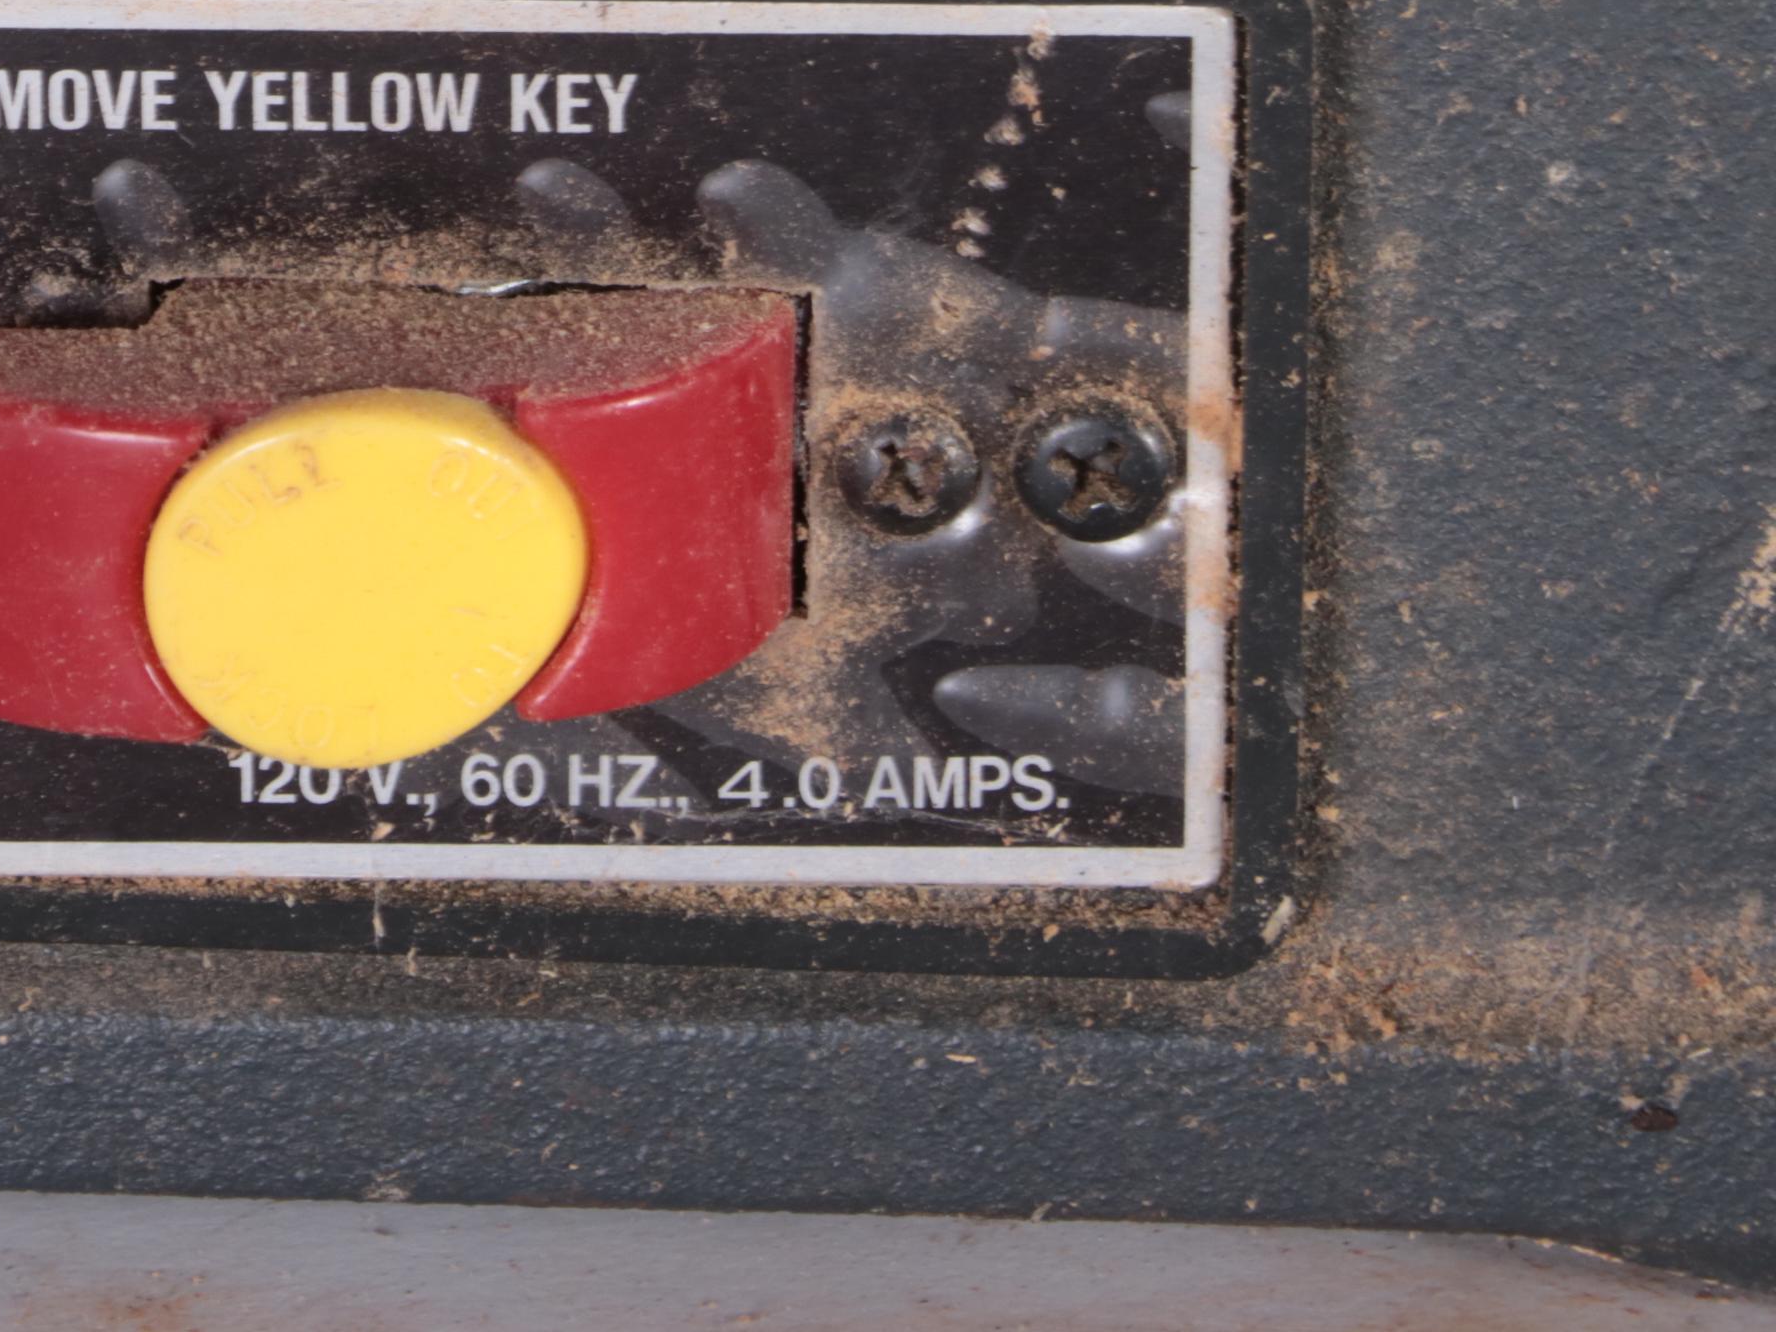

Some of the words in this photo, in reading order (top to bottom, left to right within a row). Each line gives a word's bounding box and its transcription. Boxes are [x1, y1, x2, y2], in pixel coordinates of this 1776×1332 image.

[205, 72, 479, 133] YELLOW
[511, 74, 637, 134] KEY
[228, 752, 341, 805] 120
[461, 754, 545, 808] 60
[717, 756, 841, 810] 4.0
[863, 755, 1071, 812] AMPS.
